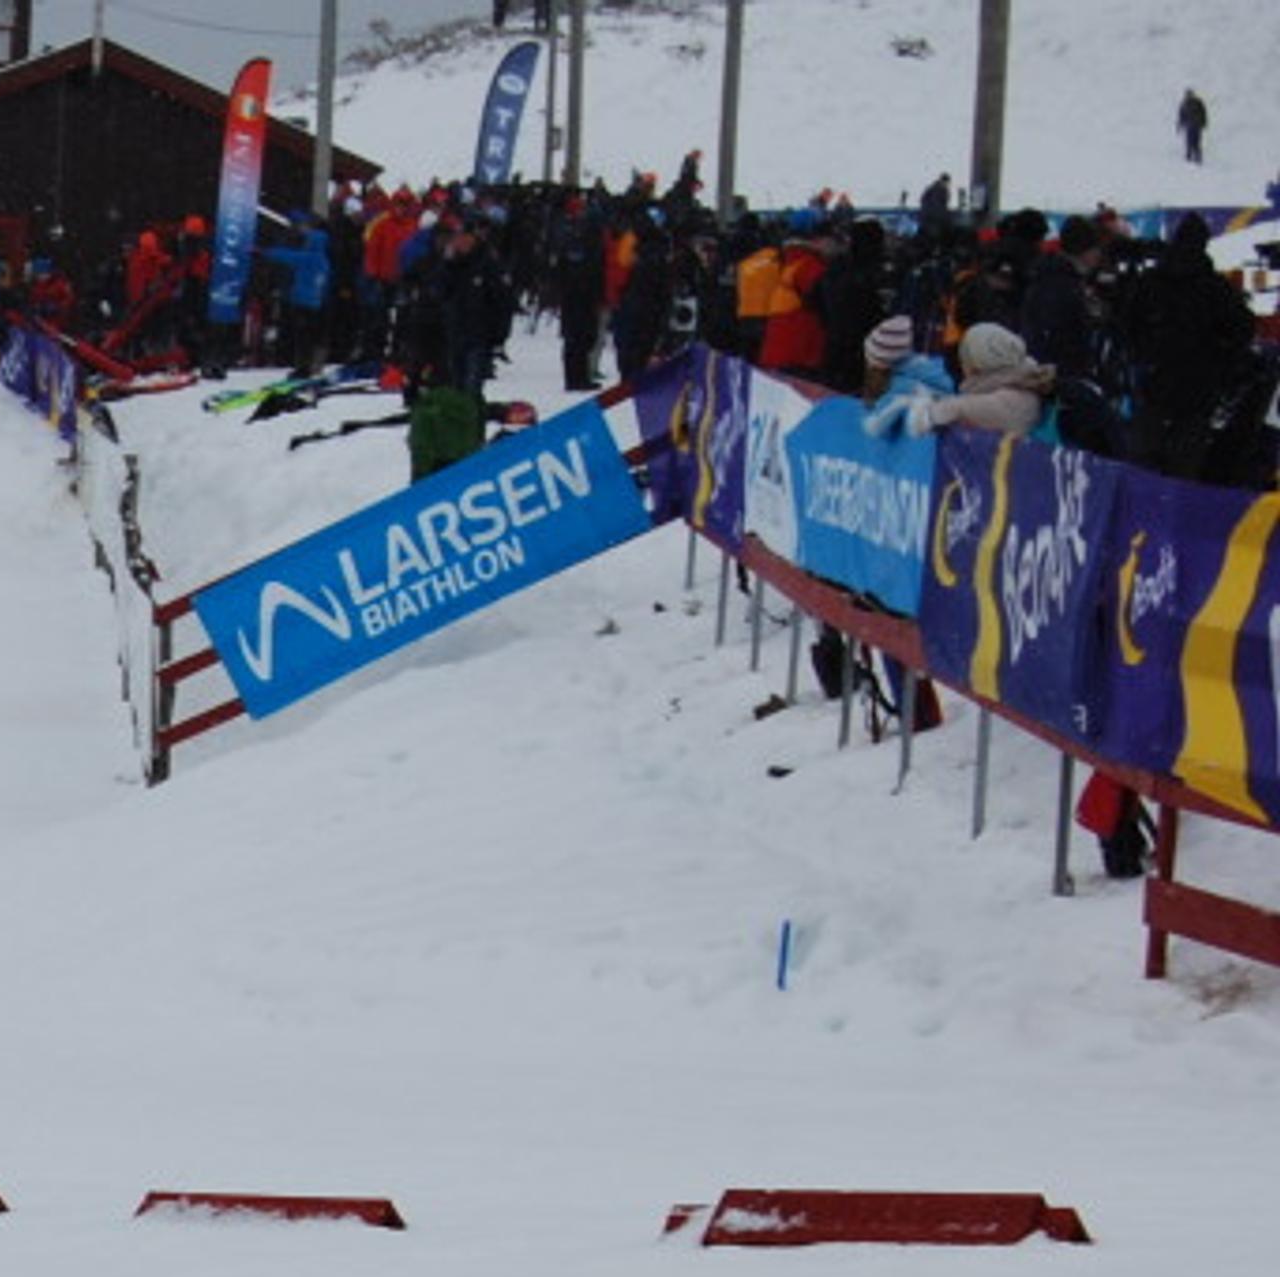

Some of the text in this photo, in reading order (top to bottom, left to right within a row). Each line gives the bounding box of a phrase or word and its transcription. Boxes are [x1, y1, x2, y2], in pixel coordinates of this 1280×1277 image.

[339, 438, 592, 605] LARSEN
[361, 536, 527, 638] BIATHLON
[1002, 445, 1089, 666] Bendit
